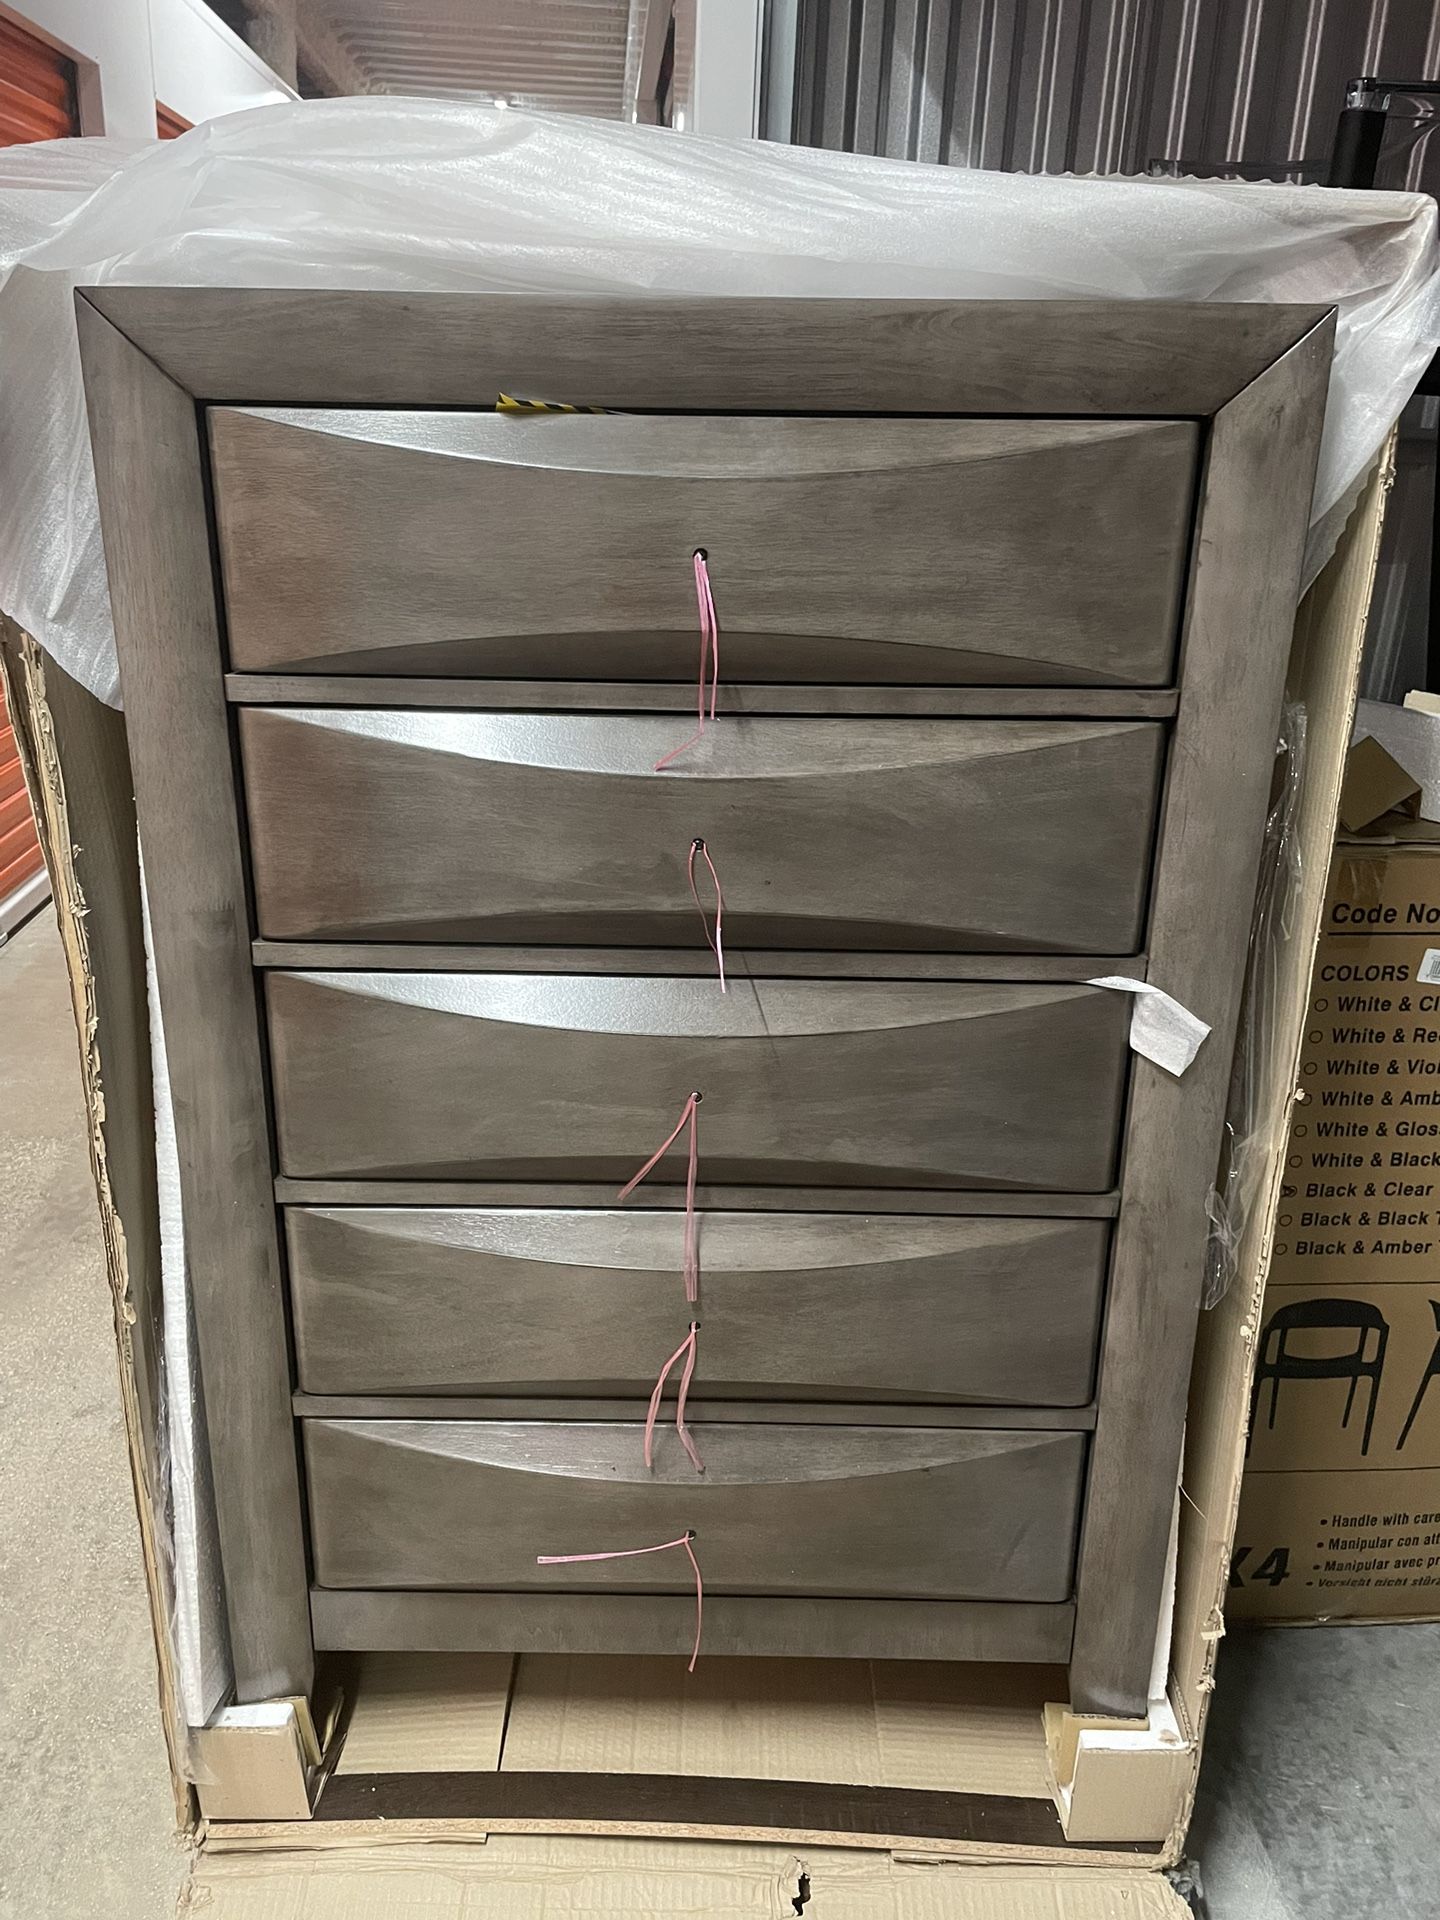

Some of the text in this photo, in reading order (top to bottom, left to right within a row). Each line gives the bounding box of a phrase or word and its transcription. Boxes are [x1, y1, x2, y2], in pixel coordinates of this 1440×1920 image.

[1332, 903, 1397, 924] Code
[1321, 965, 1409, 982] COLORS
[1338, 996, 1391, 1012] White
[1399, 996, 1411, 1011] &
[1332, 1028, 1440, 1043] White & Re
[1327, 1060, 1380, 1075] White
[1387, 1060, 1399, 1075] &
[1322, 1090, 1440, 1106] White & Amb
[1317, 1121, 1440, 1137] White & Glos
[1312, 1152, 1440, 1167] White & Black
[1306, 1182, 1434, 1197] Black & Clear
[1301, 1212, 1351, 1226] Black
[1359, 1212, 1371, 1225] &
[1378, 1211, 1429, 1226] Black
[1296, 1240, 1432, 1255] Black & Amber
[1331, 1514, 1377, 1527] Handle
[1382, 1512, 1409, 1526] with
[1328, 1536, 1393, 1552] Manipular
[1397, 1537, 1419, 1547] con
[1324, 1558, 1389, 1573] Manipular
[1394, 1558, 1423, 1569] avec
